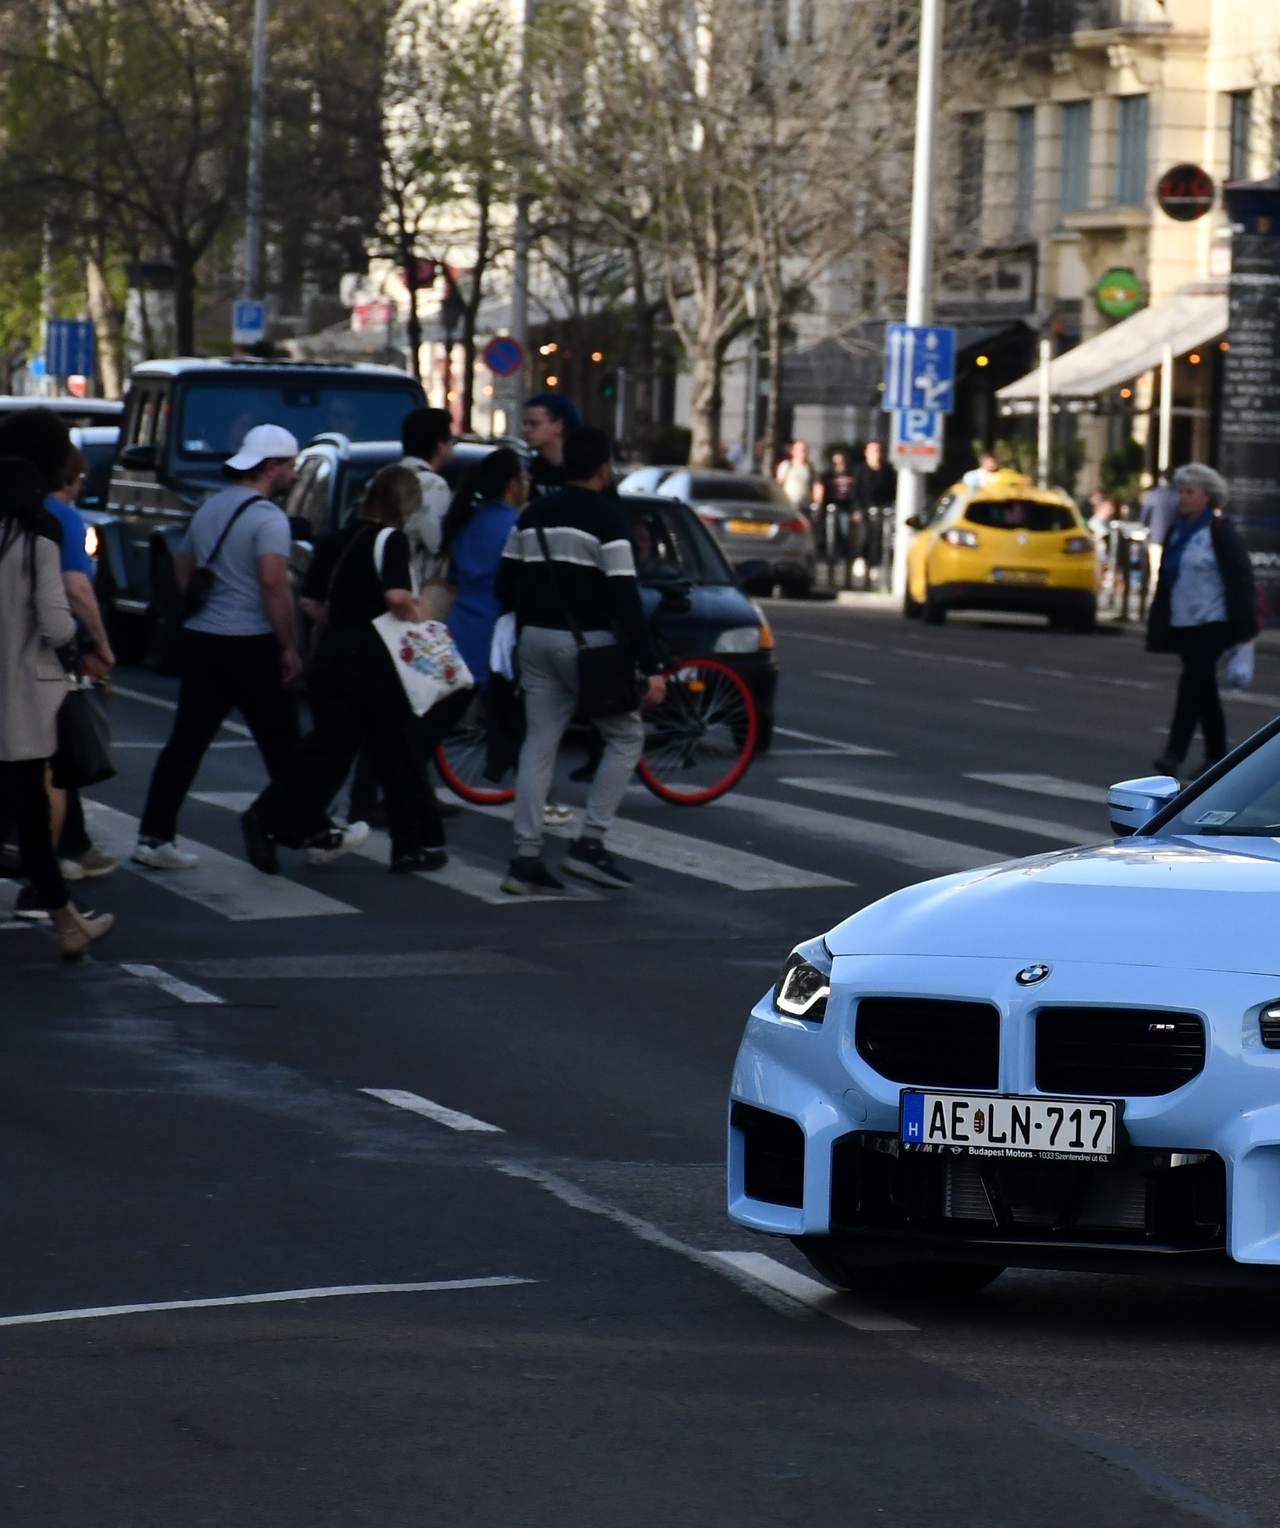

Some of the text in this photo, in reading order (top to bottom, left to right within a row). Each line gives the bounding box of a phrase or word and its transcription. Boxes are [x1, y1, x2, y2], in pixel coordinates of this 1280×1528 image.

[907, 410, 929, 441] P
[908, 1122, 918, 1137] H
[987, 1103, 1107, 1149] LN-717
[968, 1146, 1004, 1157] Budapest
[1005, 1149, 1033, 1158] Motors
[1038, 1151, 1054, 1160] 1033
[1054, 1152, 1091, 1161] Szentendrei
